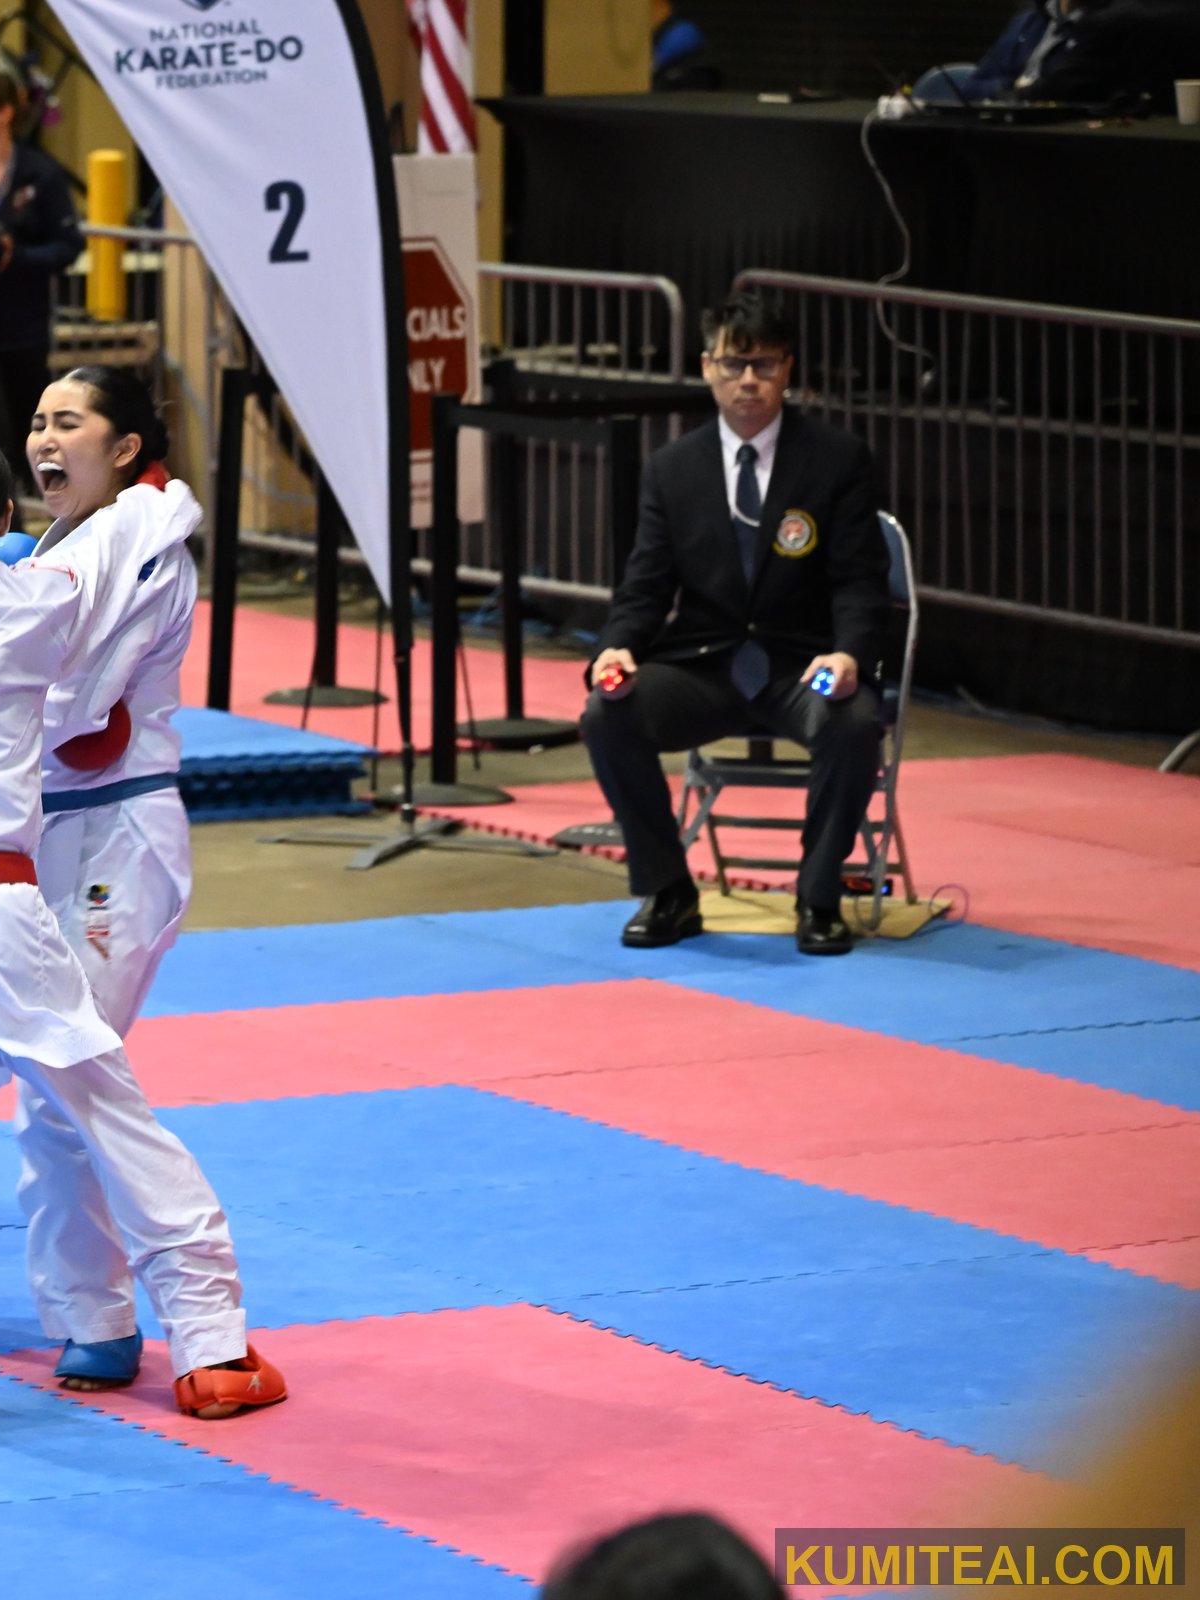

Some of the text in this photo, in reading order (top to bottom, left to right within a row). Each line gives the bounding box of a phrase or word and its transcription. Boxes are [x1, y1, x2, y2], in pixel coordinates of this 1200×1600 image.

[150, 19, 262, 41] NATIONAL
[115, 36, 304, 73] KARATE-DO
[157, 69, 268, 89] FEDERATION
[264, 180, 310, 263] 2
